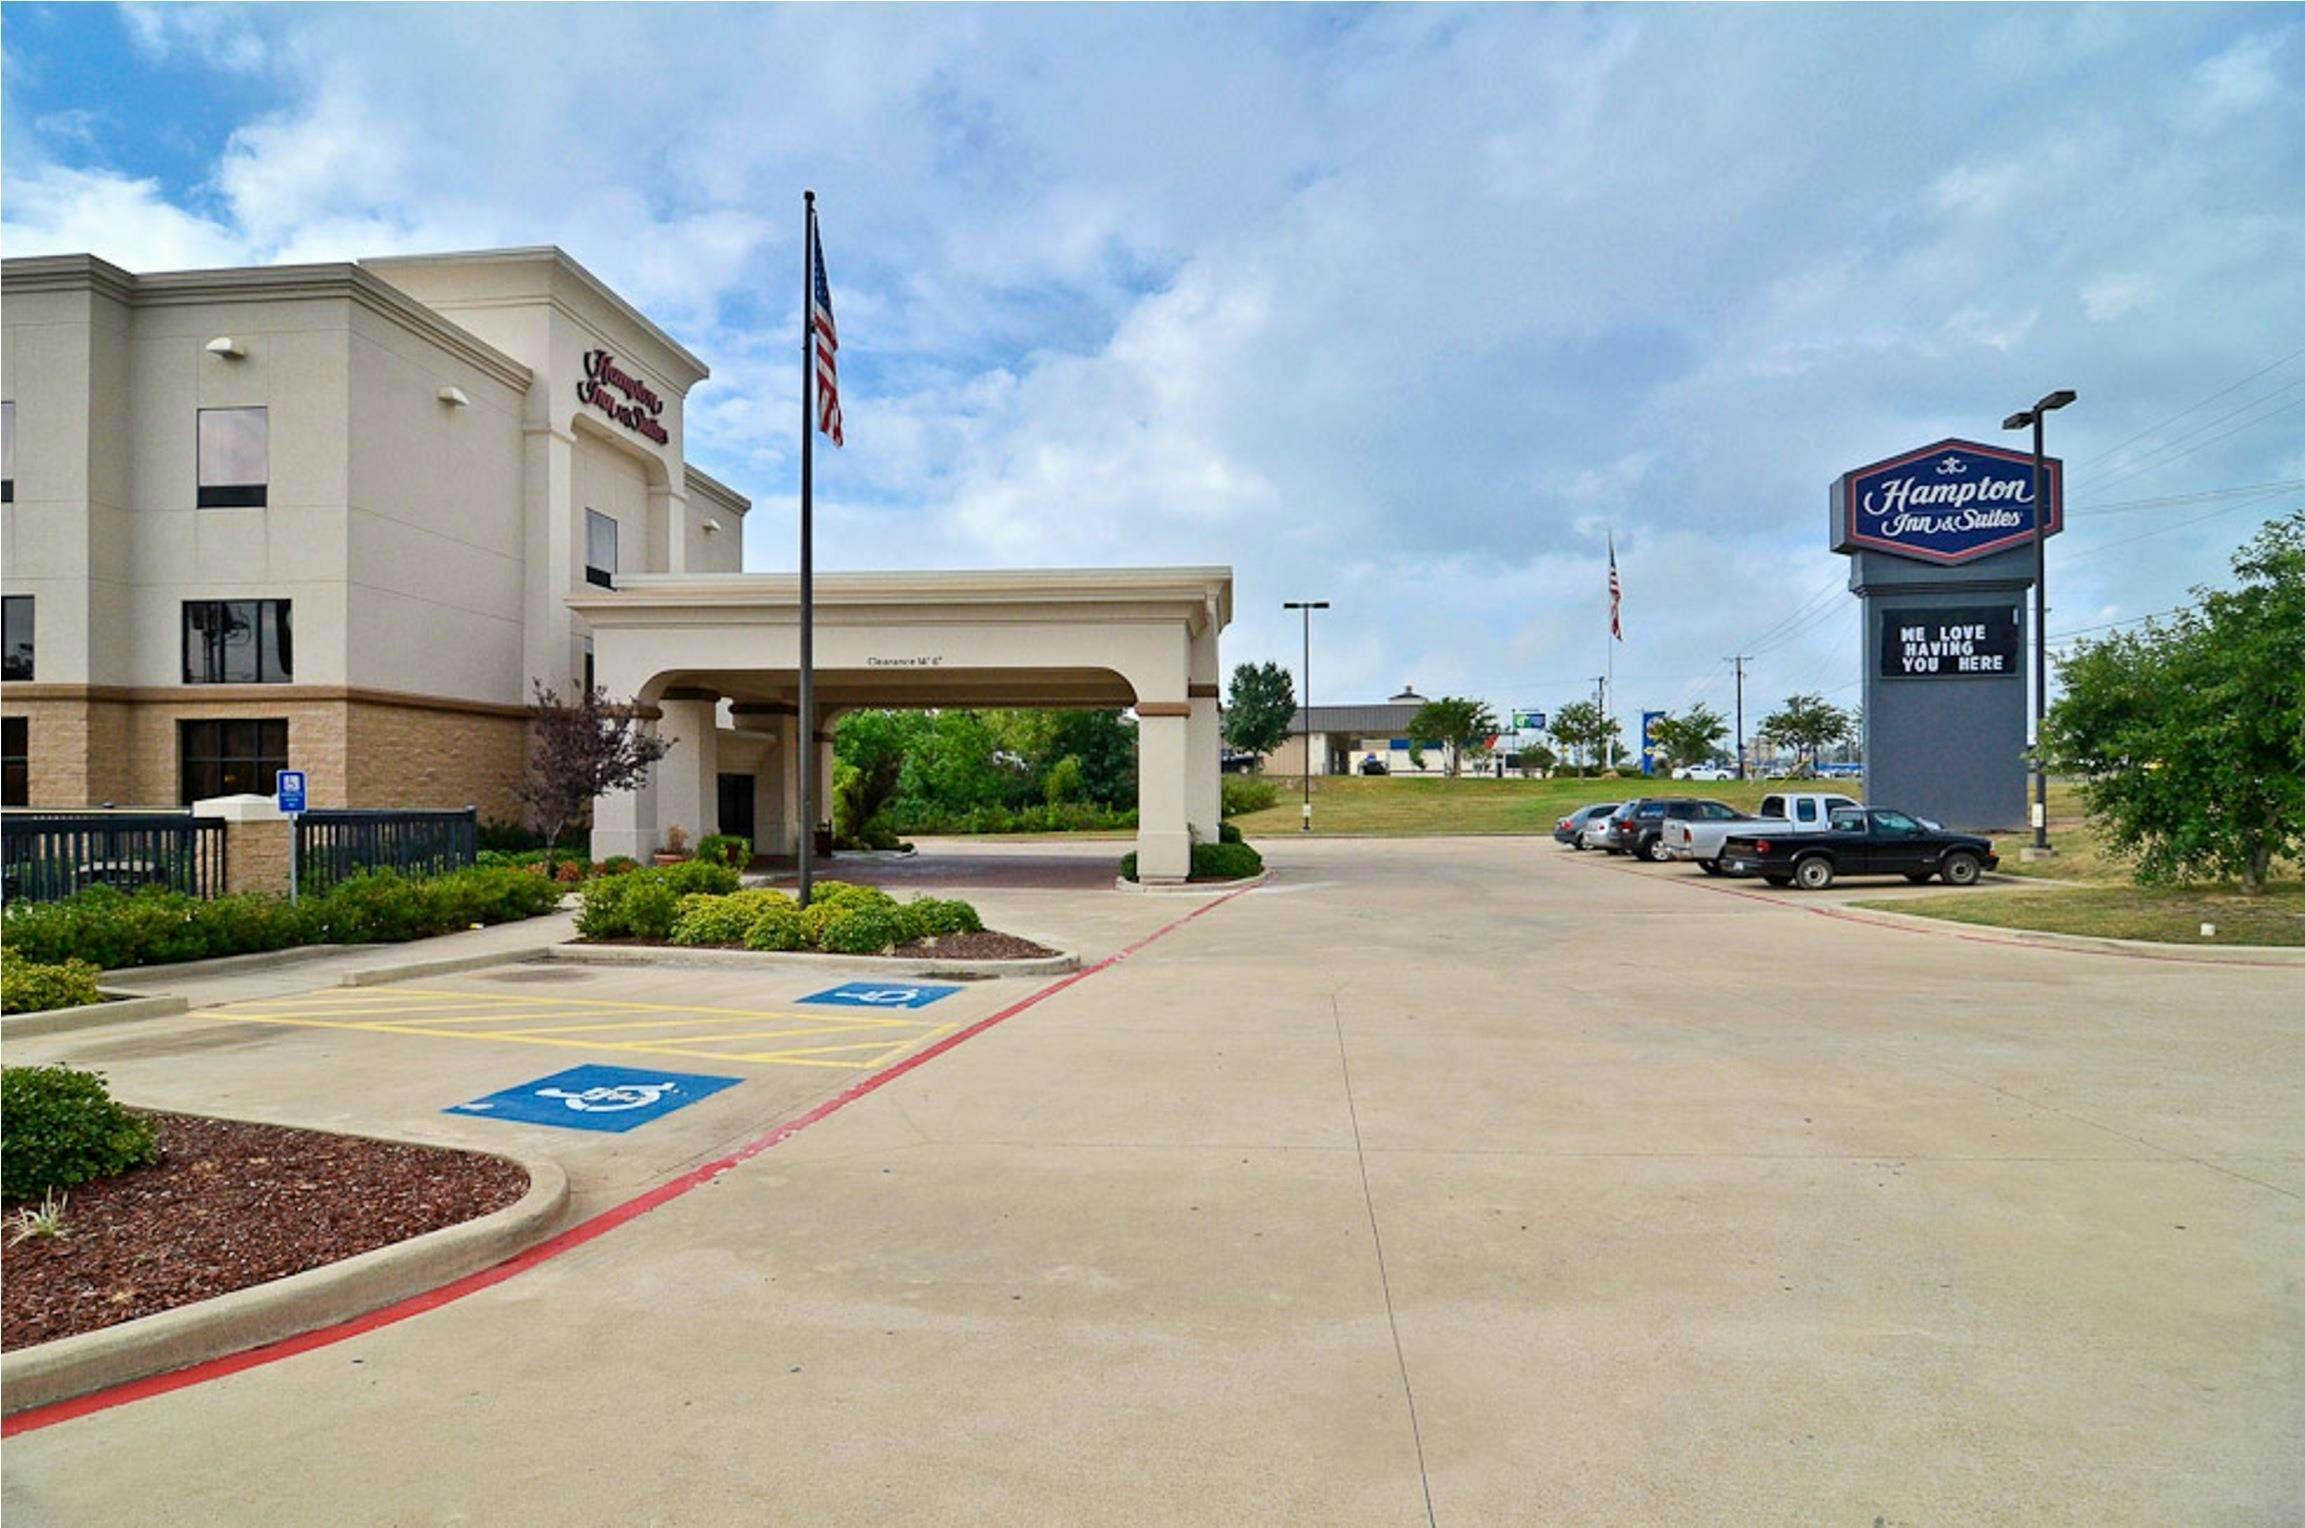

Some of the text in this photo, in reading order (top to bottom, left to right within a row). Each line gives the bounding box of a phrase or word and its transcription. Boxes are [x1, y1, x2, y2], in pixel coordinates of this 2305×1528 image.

[583, 349, 663, 415] Hampton
[577, 381, 619, 419] Inn
[630, 406, 669, 446] Suites
[1864, 476, 2035, 515] Hampton
[1881, 508, 2020, 536] Inn & Suites
[1939, 625, 1986, 641] LOVE
[1905, 640, 1974, 656] HAVING
[867, 656, 916, 665] Clearance
[1902, 655, 2003, 673] YOU HERE
